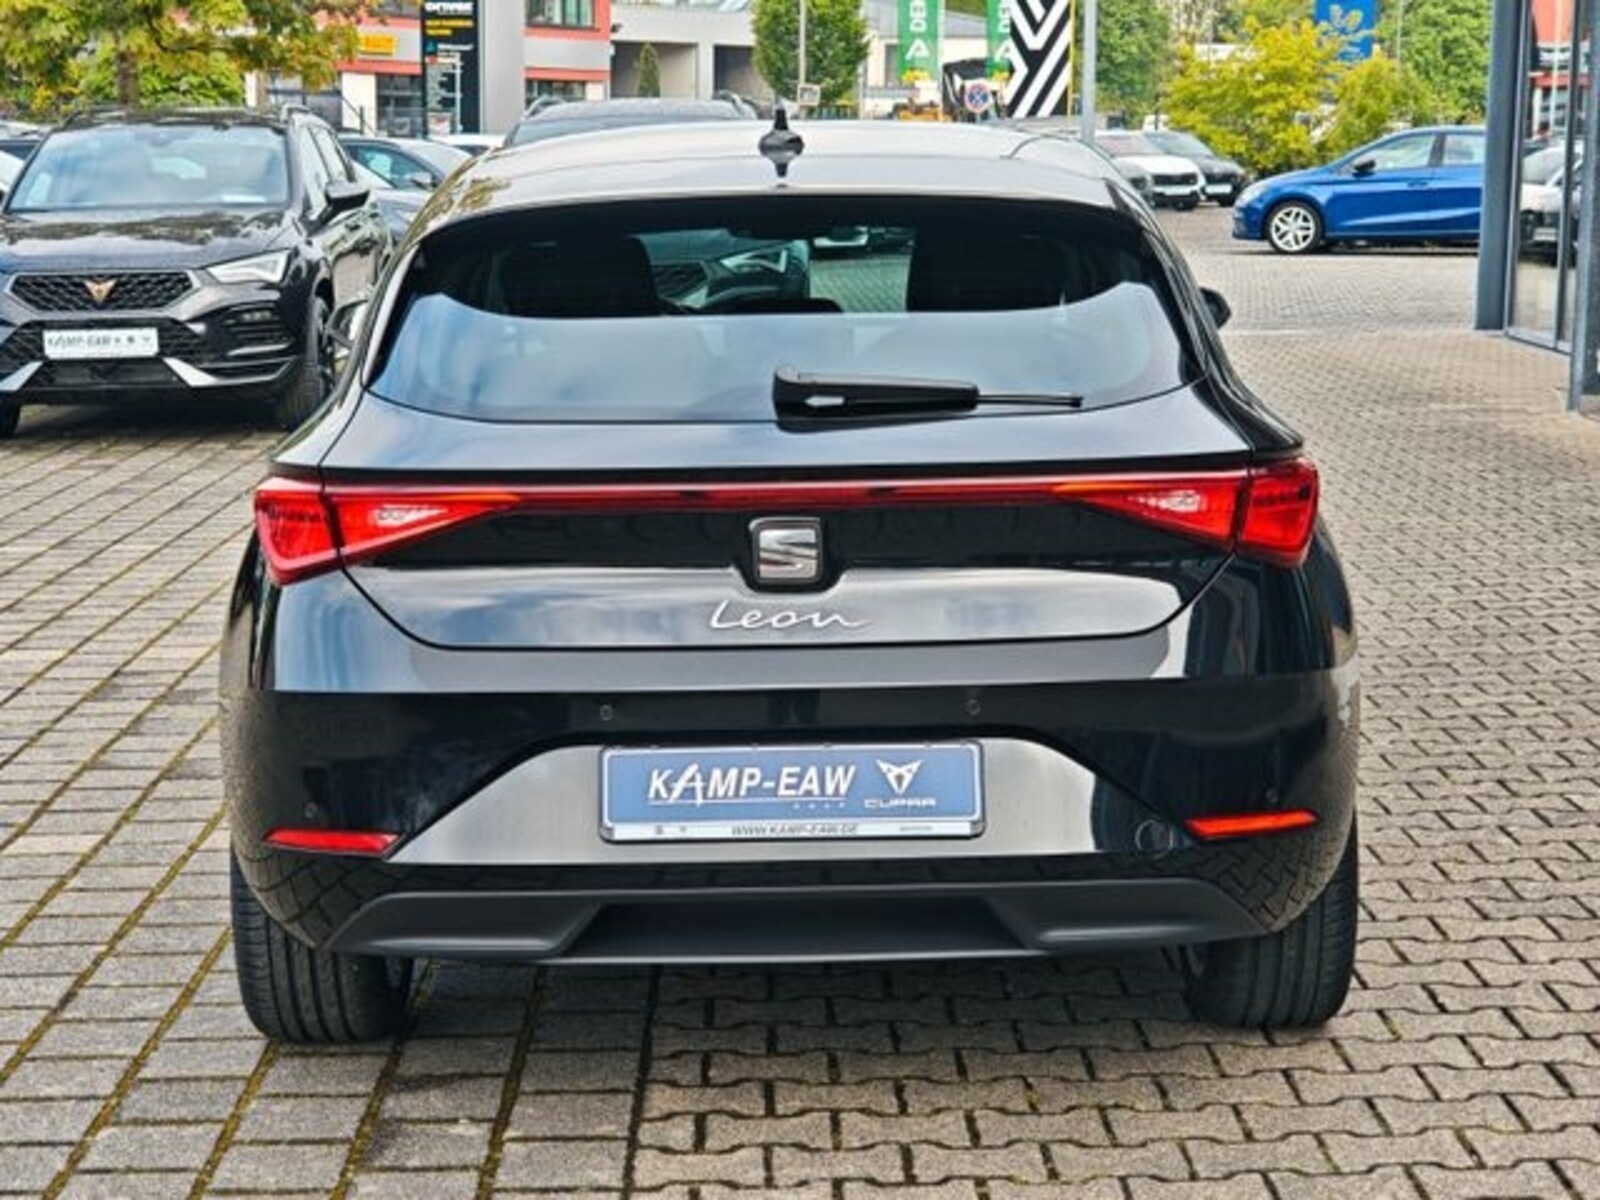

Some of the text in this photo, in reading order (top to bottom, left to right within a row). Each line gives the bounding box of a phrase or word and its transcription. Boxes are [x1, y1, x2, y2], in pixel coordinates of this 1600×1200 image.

[709, 598, 873, 629] Leon
[647, 763, 856, 807] KAMP-EAW
[864, 798, 937, 809] CUPRA
